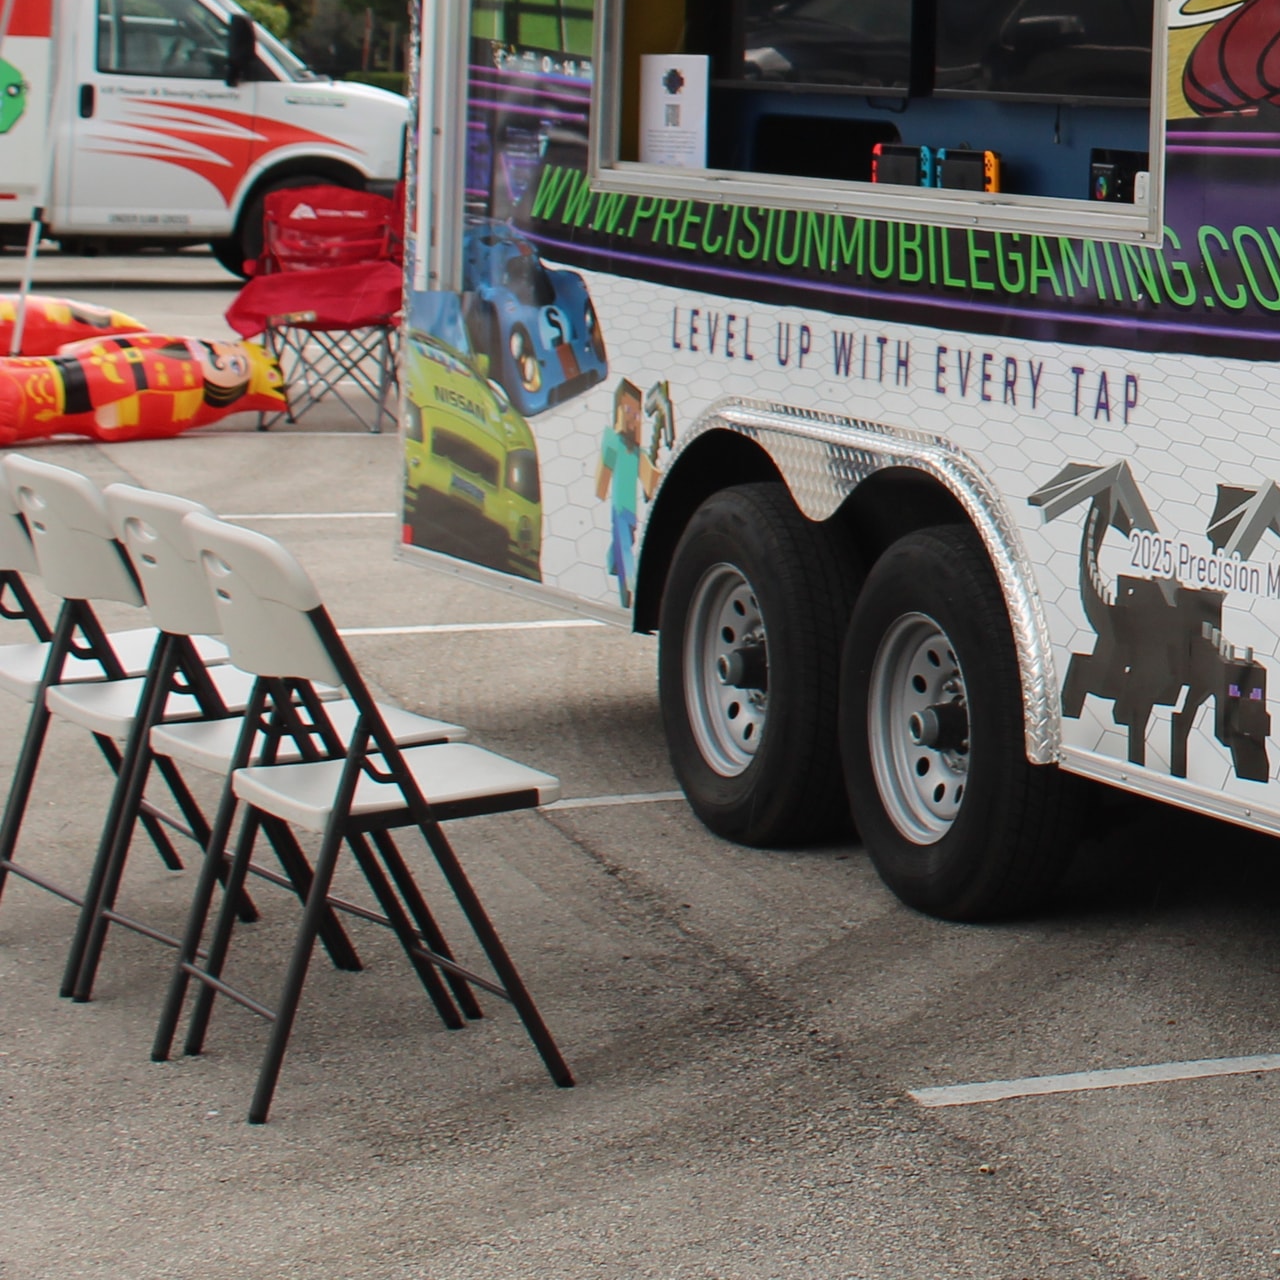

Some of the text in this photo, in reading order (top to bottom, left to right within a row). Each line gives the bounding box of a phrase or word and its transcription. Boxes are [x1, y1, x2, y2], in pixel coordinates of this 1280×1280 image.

[672, 307, 1140, 425] LEVEL UP WITH EVERY TAP
[434, 385, 487, 423] NISSAN
[1130, 532, 1173, 575] 2025
[1178, 543, 1261, 594] Precision
